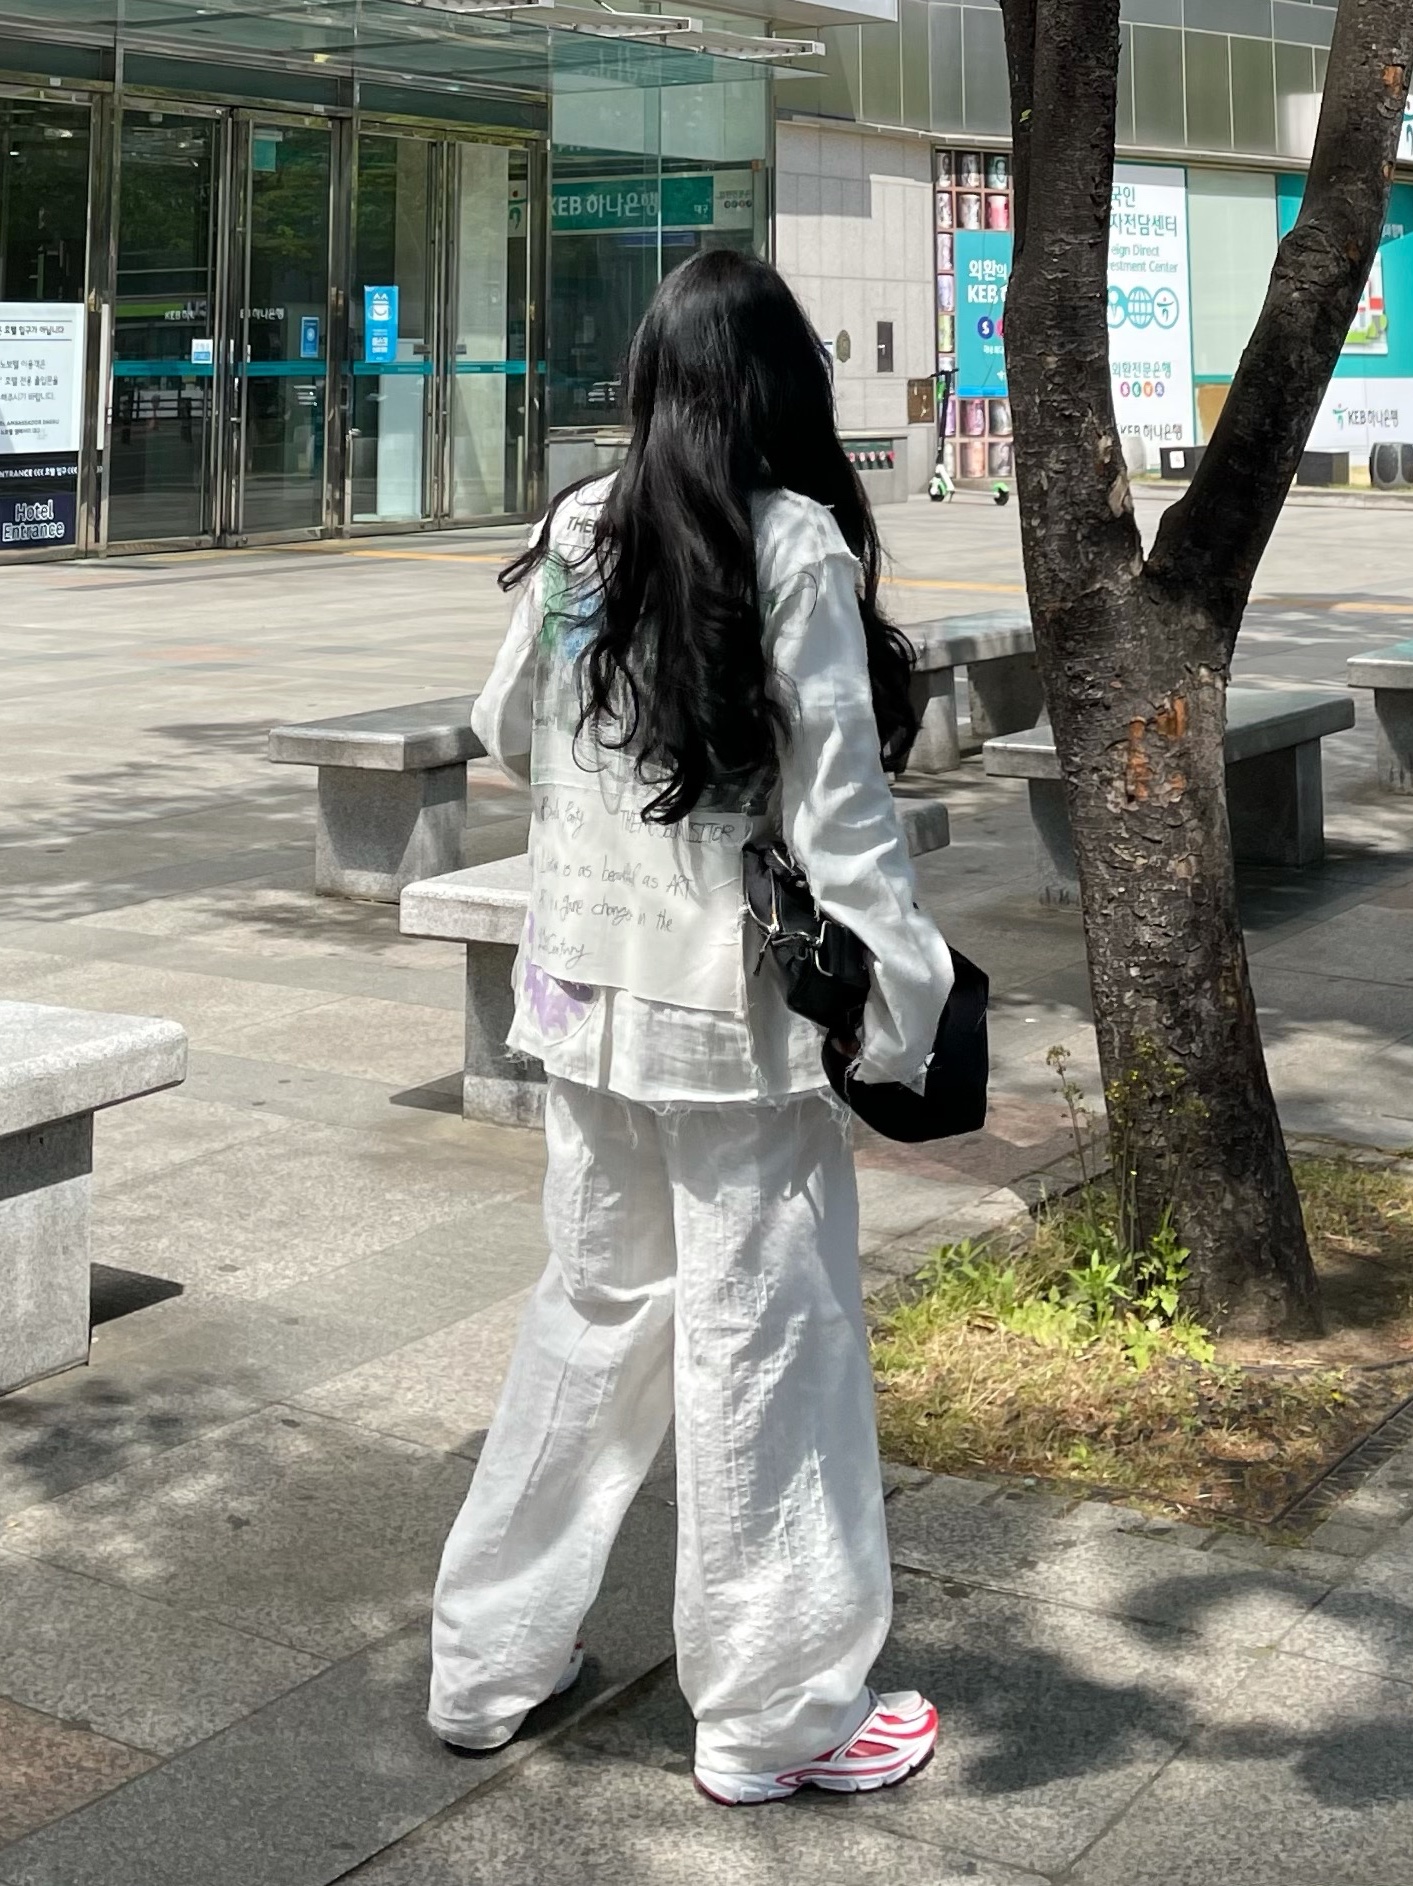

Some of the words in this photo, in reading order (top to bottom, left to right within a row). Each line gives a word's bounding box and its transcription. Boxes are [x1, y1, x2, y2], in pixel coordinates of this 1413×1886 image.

[586, 192, 660, 218] 하나은행
[1109, 212, 1178, 238] 자전담센터
[1133, 244, 1160, 257] Direct
[1149, 260, 1178, 273] Center
[967, 284, 998, 303] KEB
[14, 498, 55, 523] Hotel
[2, 522, 66, 543] Entrance
[642, 874, 660, 889] as
